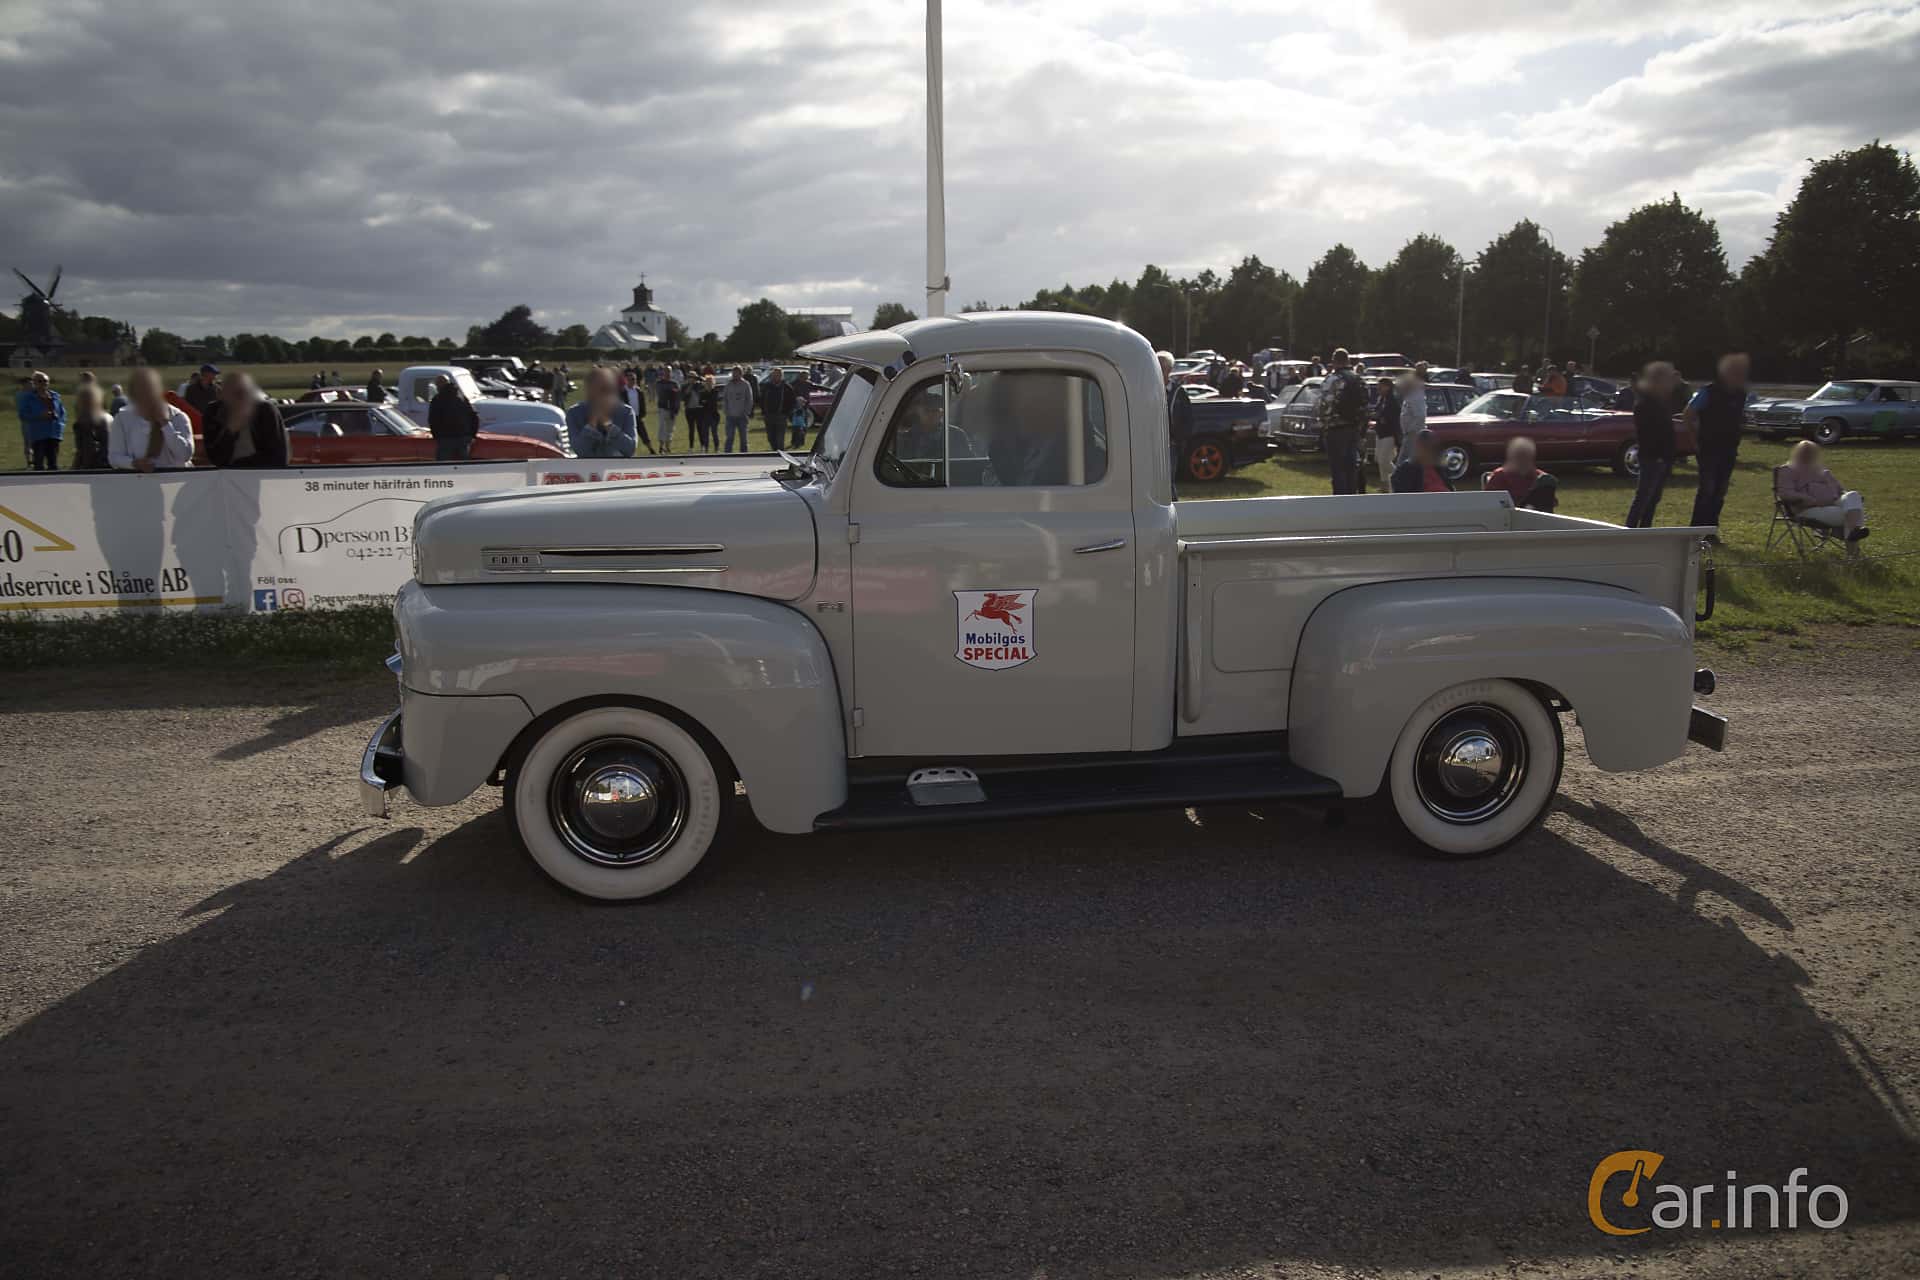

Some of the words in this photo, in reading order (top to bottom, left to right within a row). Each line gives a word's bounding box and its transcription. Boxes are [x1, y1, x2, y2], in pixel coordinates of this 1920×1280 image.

[304, 481, 320, 492] 38
[322, 480, 369, 491] minuter
[373, 478, 421, 490] härifrån
[424, 478, 454, 489] finns
[86, 572, 95, 595] i
[97, 570, 155, 595] Skåne
[161, 567, 189, 593] AB
[965, 632, 1026, 647] Mobilgas
[963, 647, 1030, 661] SPECIAL
